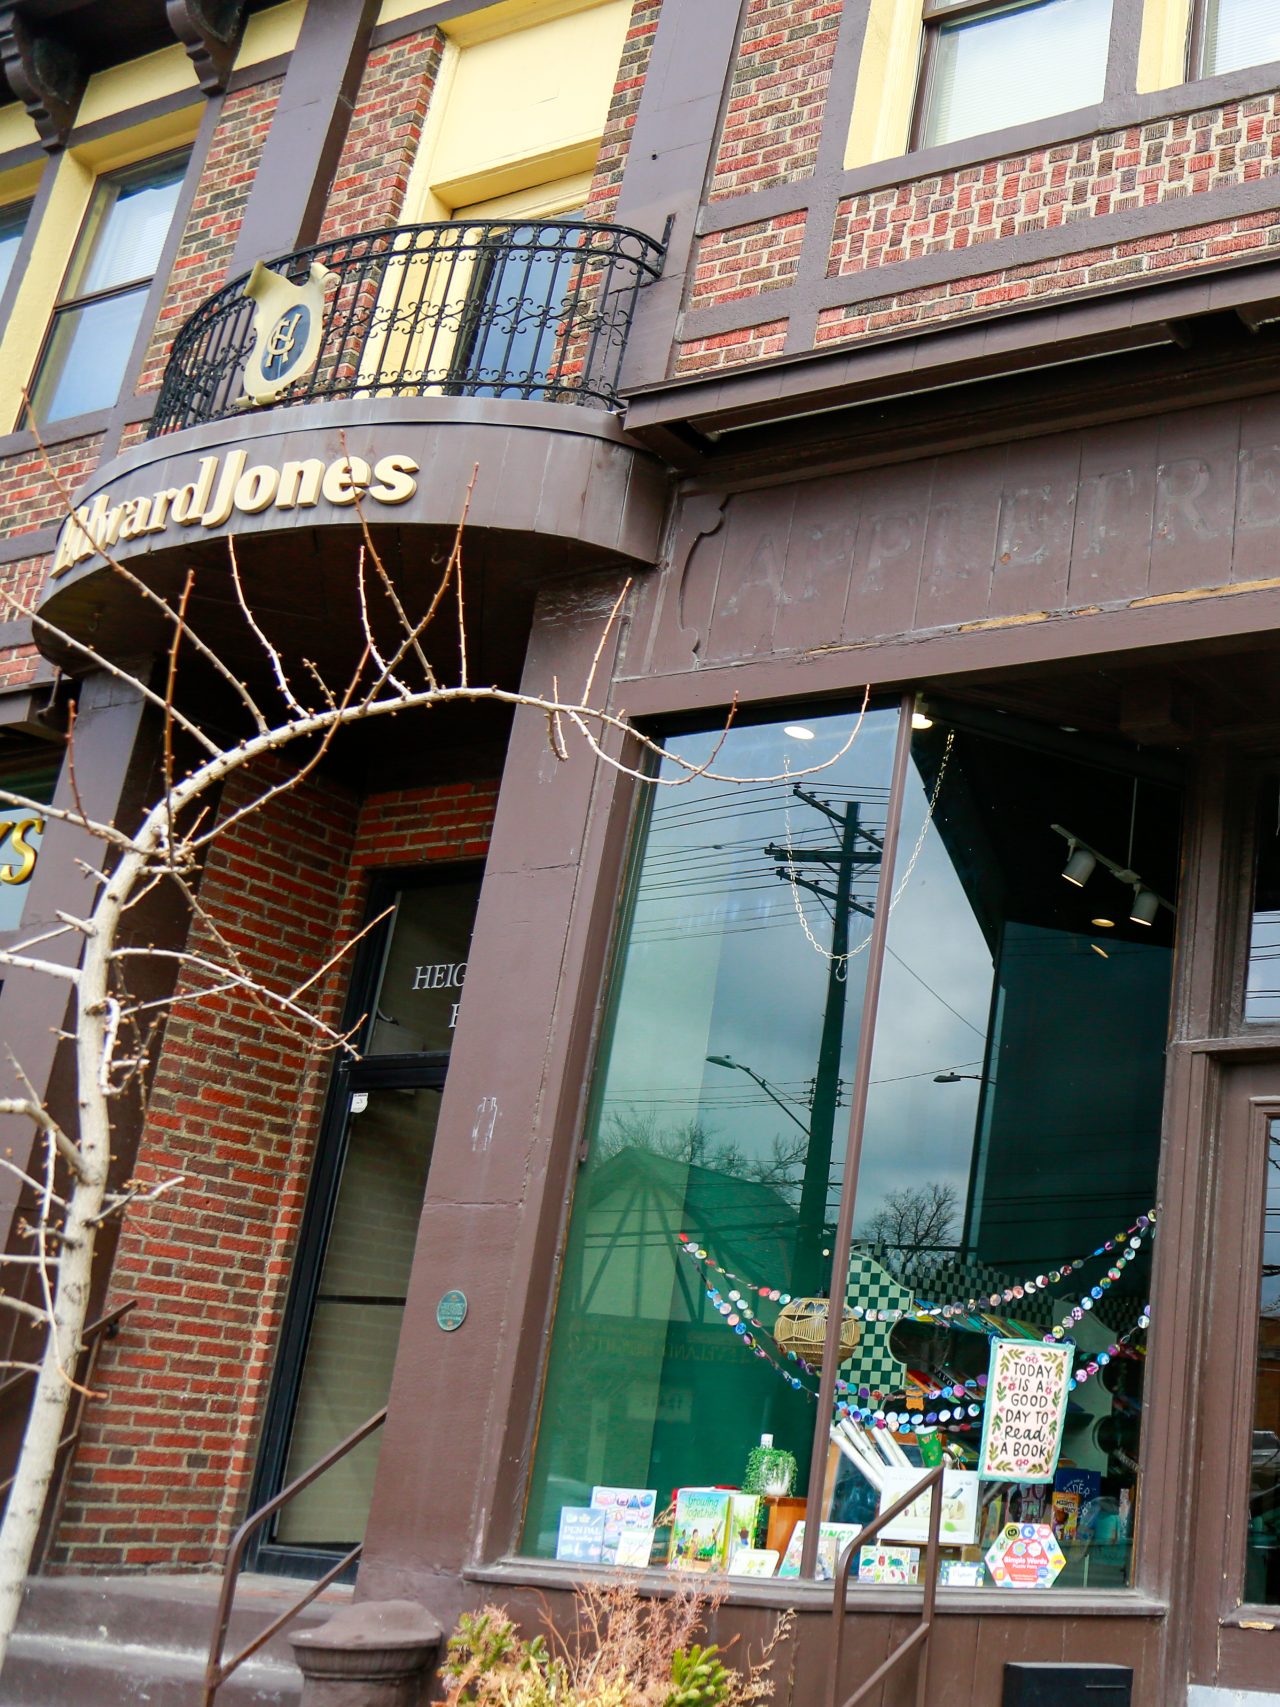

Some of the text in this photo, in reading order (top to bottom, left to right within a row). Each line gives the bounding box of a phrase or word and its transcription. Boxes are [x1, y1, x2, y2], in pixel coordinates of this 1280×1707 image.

[1014, 1362, 1053, 1379] TODAY
[1018, 1379, 1044, 1393] IS A
[1011, 1393, 1048, 1408] GOOD
[1005, 1410, 1049, 1425] DAY TO
[1000, 1442, 1047, 1458] A BOOK
[688, 1494, 720, 1511] Growing
[1004, 1556, 1048, 1565] Simple Words
